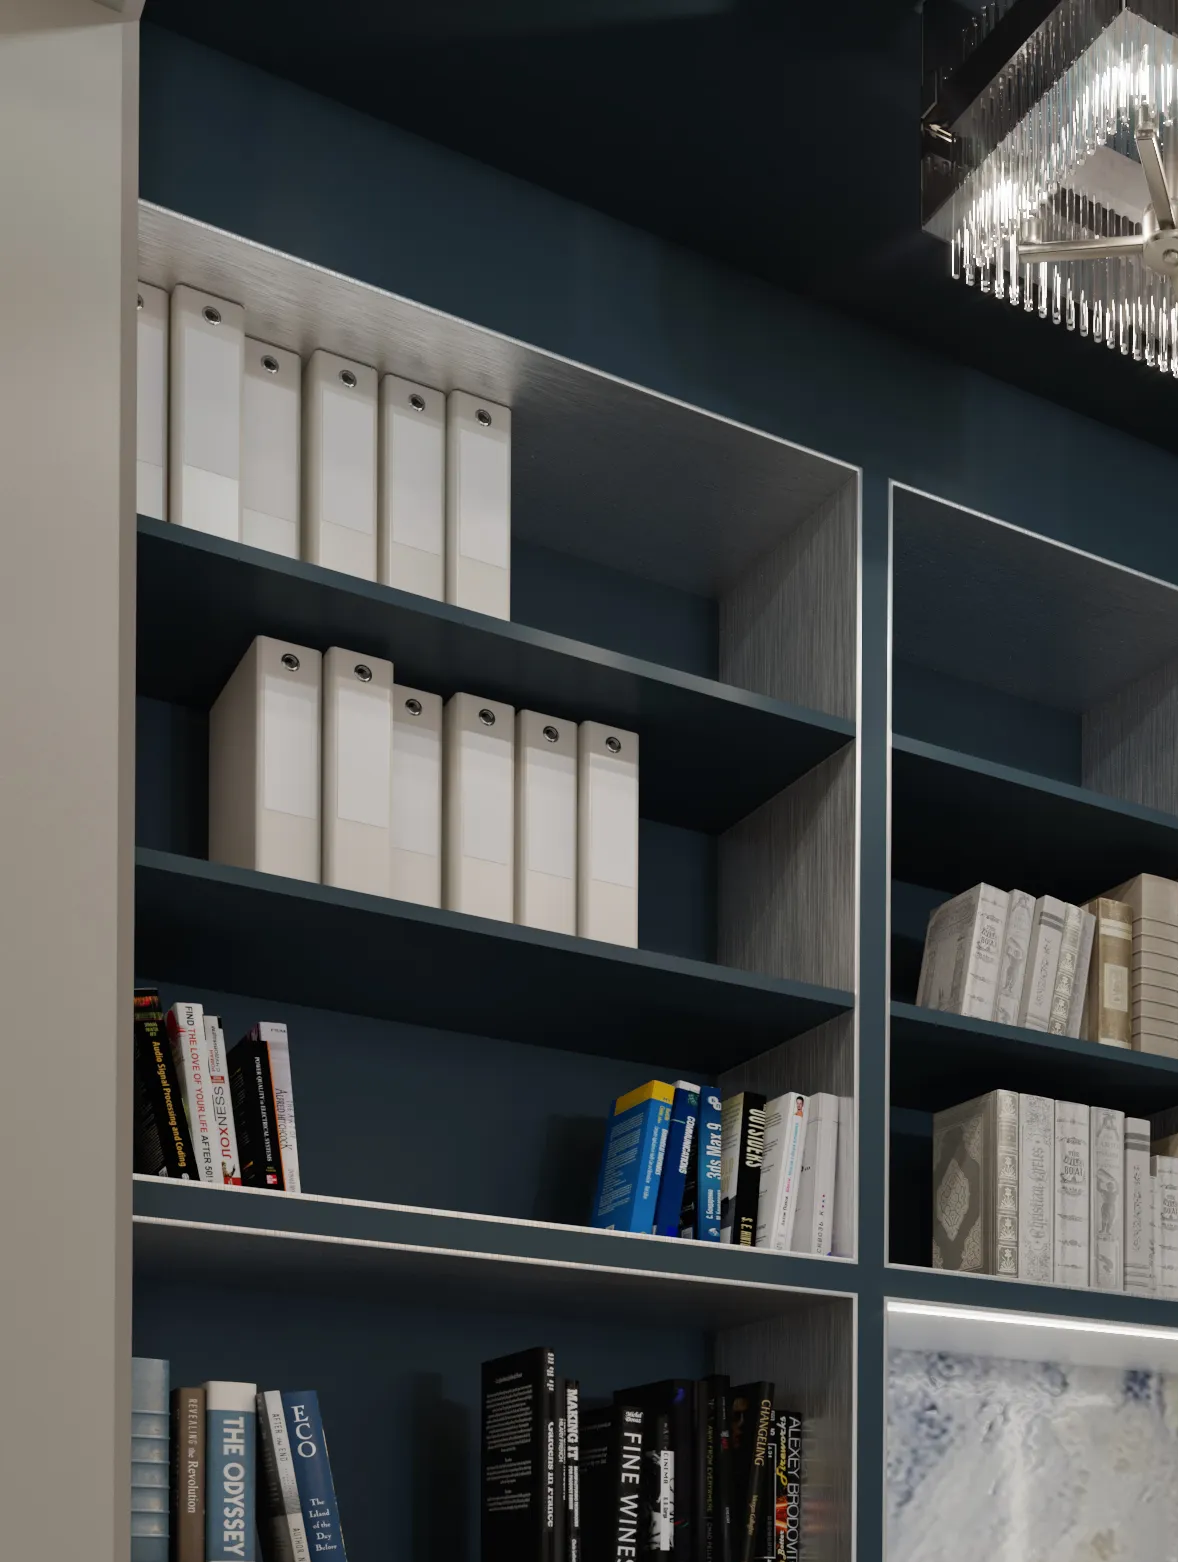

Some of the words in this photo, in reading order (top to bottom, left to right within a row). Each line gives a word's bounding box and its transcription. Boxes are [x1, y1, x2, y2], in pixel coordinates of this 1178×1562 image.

[185, 1006, 194, 1026] FIND
[188, 1028, 197, 1046] THE
[152, 1041, 162, 1065] Audio
[190, 1047, 200, 1071] LOVE
[159, 1065, 170, 1088] Signal
[194, 1073, 201, 1086] OF
[164, 1089, 178, 1128] Processing
[195, 1086, 204, 1114] YOUR
[275, 1087, 289, 1112] ALFRED
[172, 1126, 180, 1142] and
[198, 1113, 208, 1133] LIFE
[260, 1107, 270, 1137] ELECTRICAL
[278, 1112, 293, 1151] HITCHCOCK
[706, 1122, 722, 1132] 9
[201, 1135, 211, 1163] AFTER
[263, 1137, 273, 1162] SYSTEMS
[679, 1115, 696, 1175] COMMUNICATIONS
[707, 1131, 721, 1155] Max
[745, 1108, 767, 1169] OUTSIDERS
[175, 1142, 187, 1168] Coding
[706, 1156, 721, 1180] 3ds
[205, 1165, 213, 1179] 50!
[188, 1398, 198, 1446] REVEALING
[566, 1388, 579, 1444] MAKING
[223, 1417, 245, 1456] THE
[272, 1413, 283, 1434] AFTER
[279, 1447, 289, 1462] END
[291, 1405, 317, 1458] ECO
[754, 1399, 771, 1467] CHANGELING
[567, 1446, 580, 1461] IT
[621, 1431, 642, 1485] FINE
[776, 1416, 788, 1486] Fireworks
[787, 1416, 800, 1480] ALEXEY
[187, 1460, 198, 1514] Revolution
[223, 1462, 245, 1557] ODYSSEY
[309, 1498, 325, 1506] The
[312, 1521, 320, 1529] of
[316, 1532, 332, 1541] Day
[293, 1527, 304, 1554] AUTHOR
